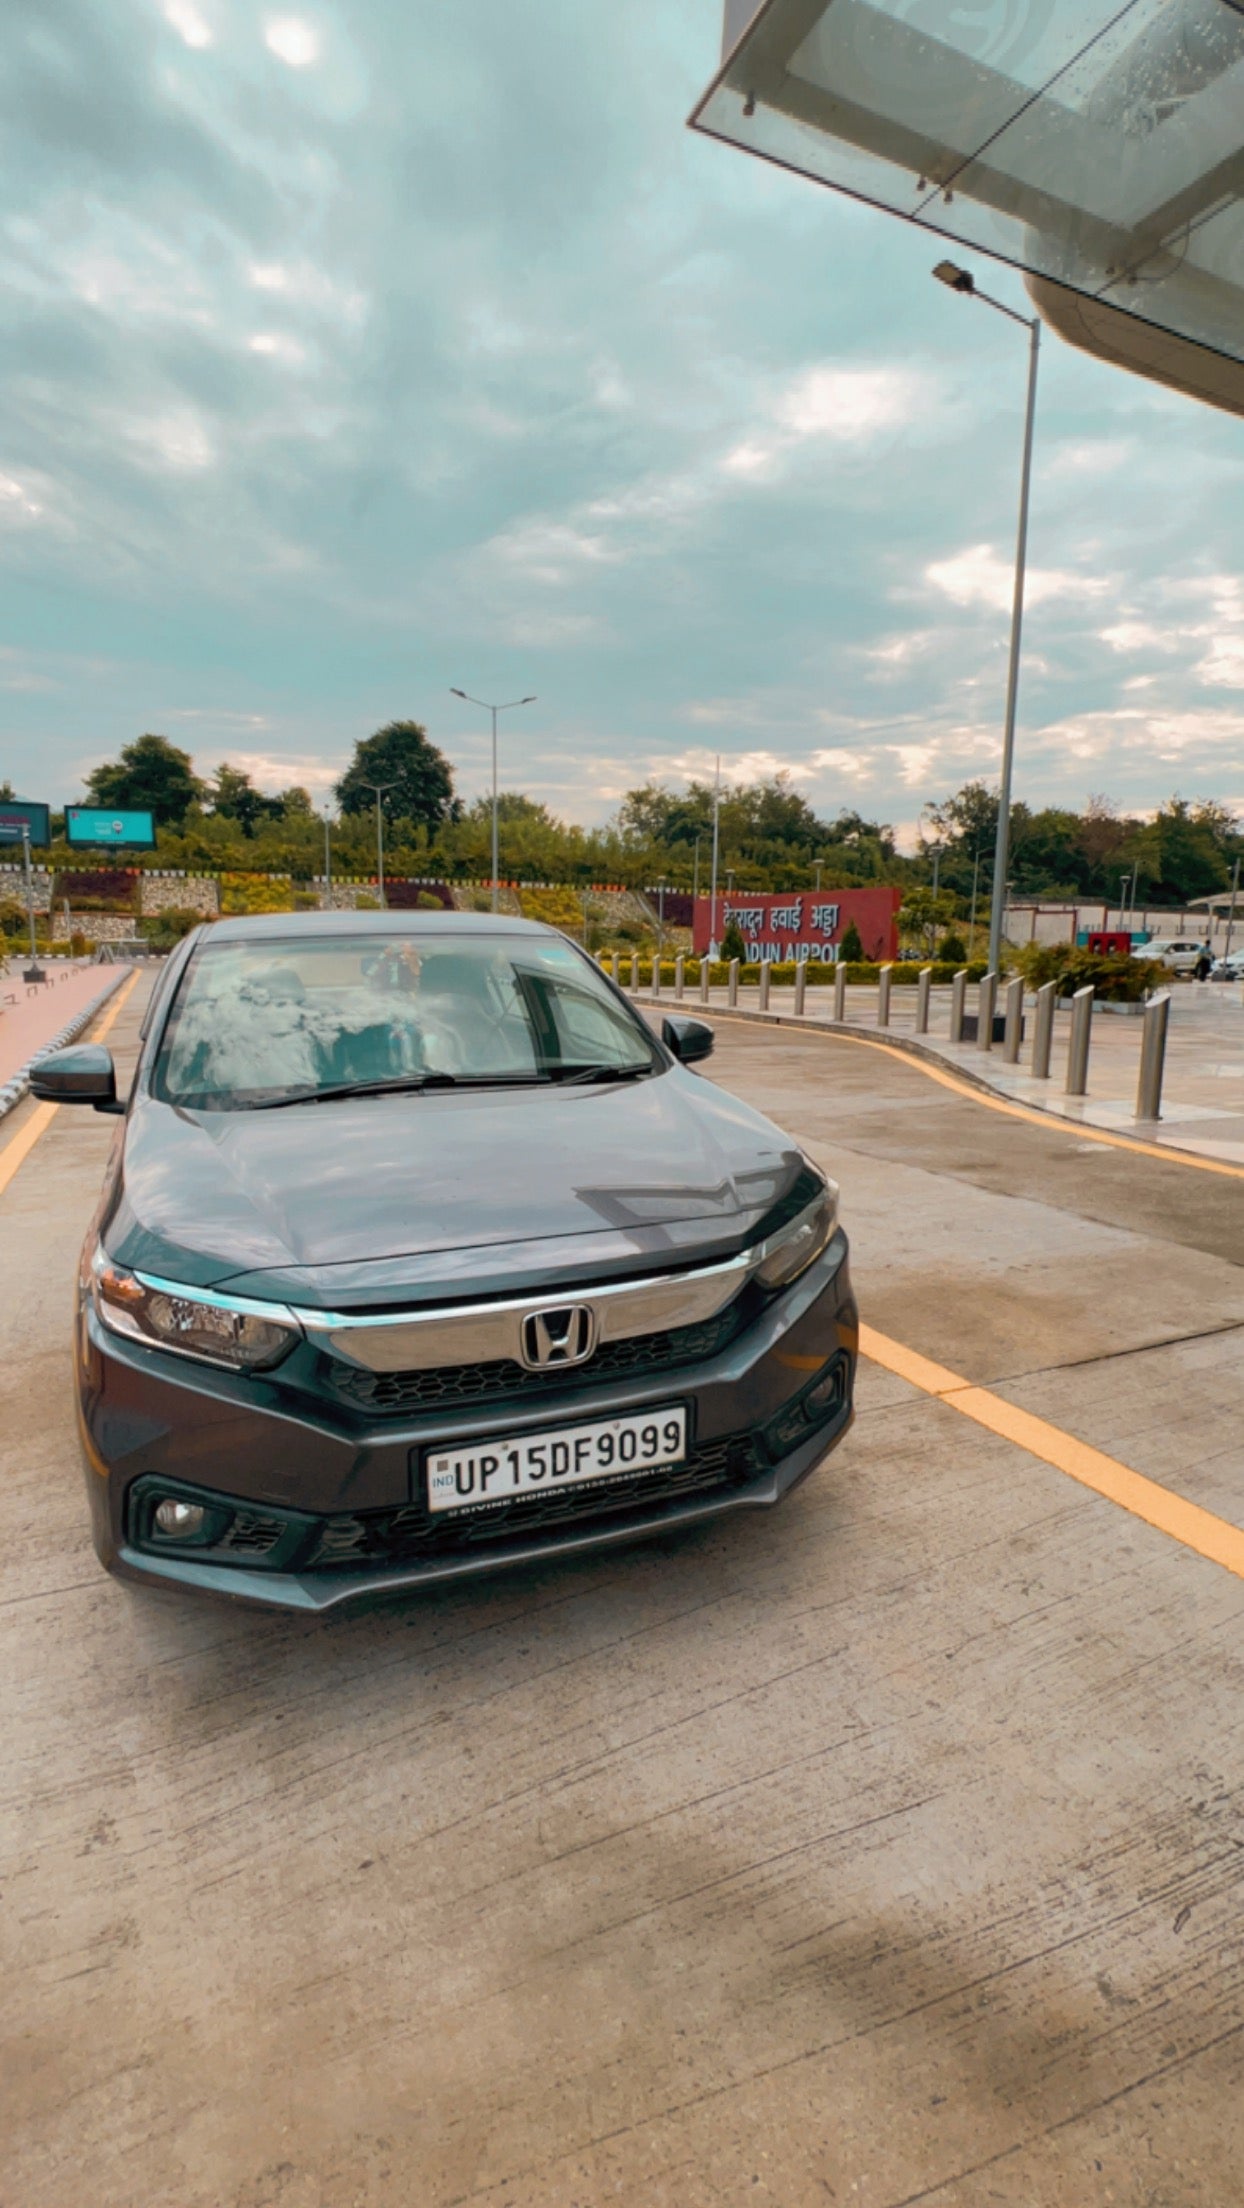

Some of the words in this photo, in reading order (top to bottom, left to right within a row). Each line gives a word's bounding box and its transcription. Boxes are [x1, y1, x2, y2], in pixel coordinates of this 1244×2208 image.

[723, 902, 764, 938] देरादून
[770, 897, 802, 934] हवाई
[811, 903, 839, 937] अड्डा
[784, 943, 841, 964] AIRPO
[455, 1420, 680, 1496] UP15DF9099
[432, 1474, 454, 1488] IND
[460, 1499, 512, 1515] DIVINE
[515, 1487, 566, 1503] HONDA
